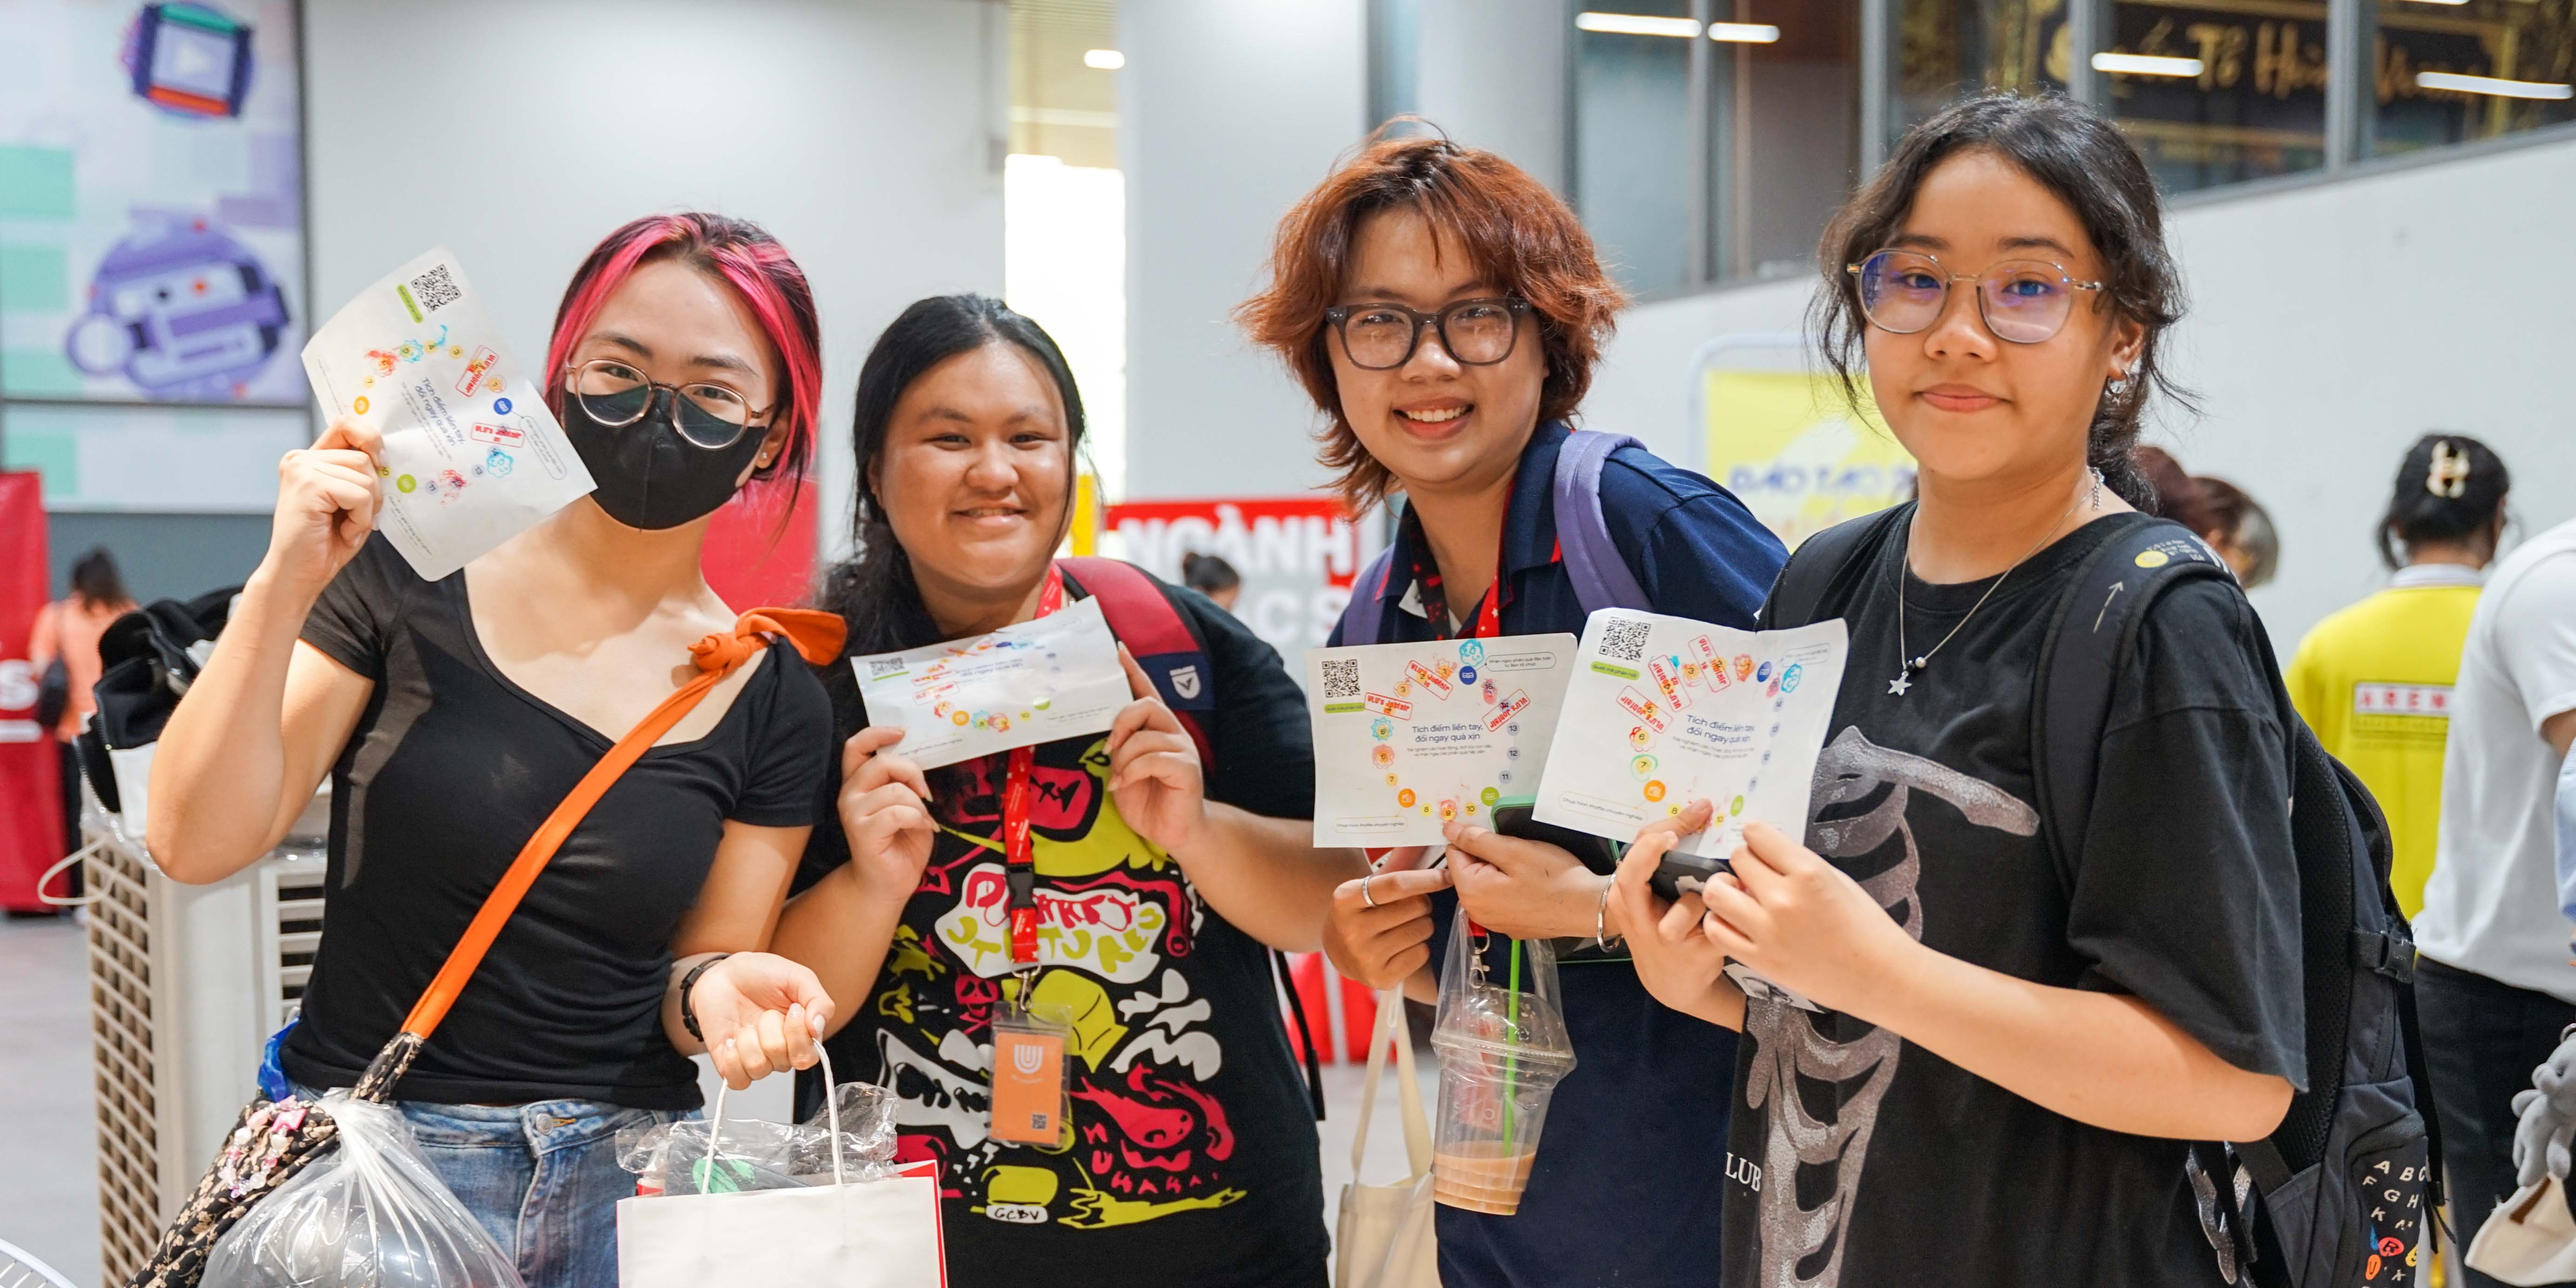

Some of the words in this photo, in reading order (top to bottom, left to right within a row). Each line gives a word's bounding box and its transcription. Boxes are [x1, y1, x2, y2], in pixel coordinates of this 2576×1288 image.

[1686, 714, 1708, 726] Tích
[1709, 720, 1733, 732] điểm
[1468, 732, 1480, 740] xịn
[1703, 732, 1729, 745] ngay
[2374, 1161, 2390, 1174] A
[2399, 1167, 2414, 1181] B
[2384, 1189, 2400, 1202] G
[2407, 1194, 2419, 1208] H
[2371, 1207, 2386, 1221] K
